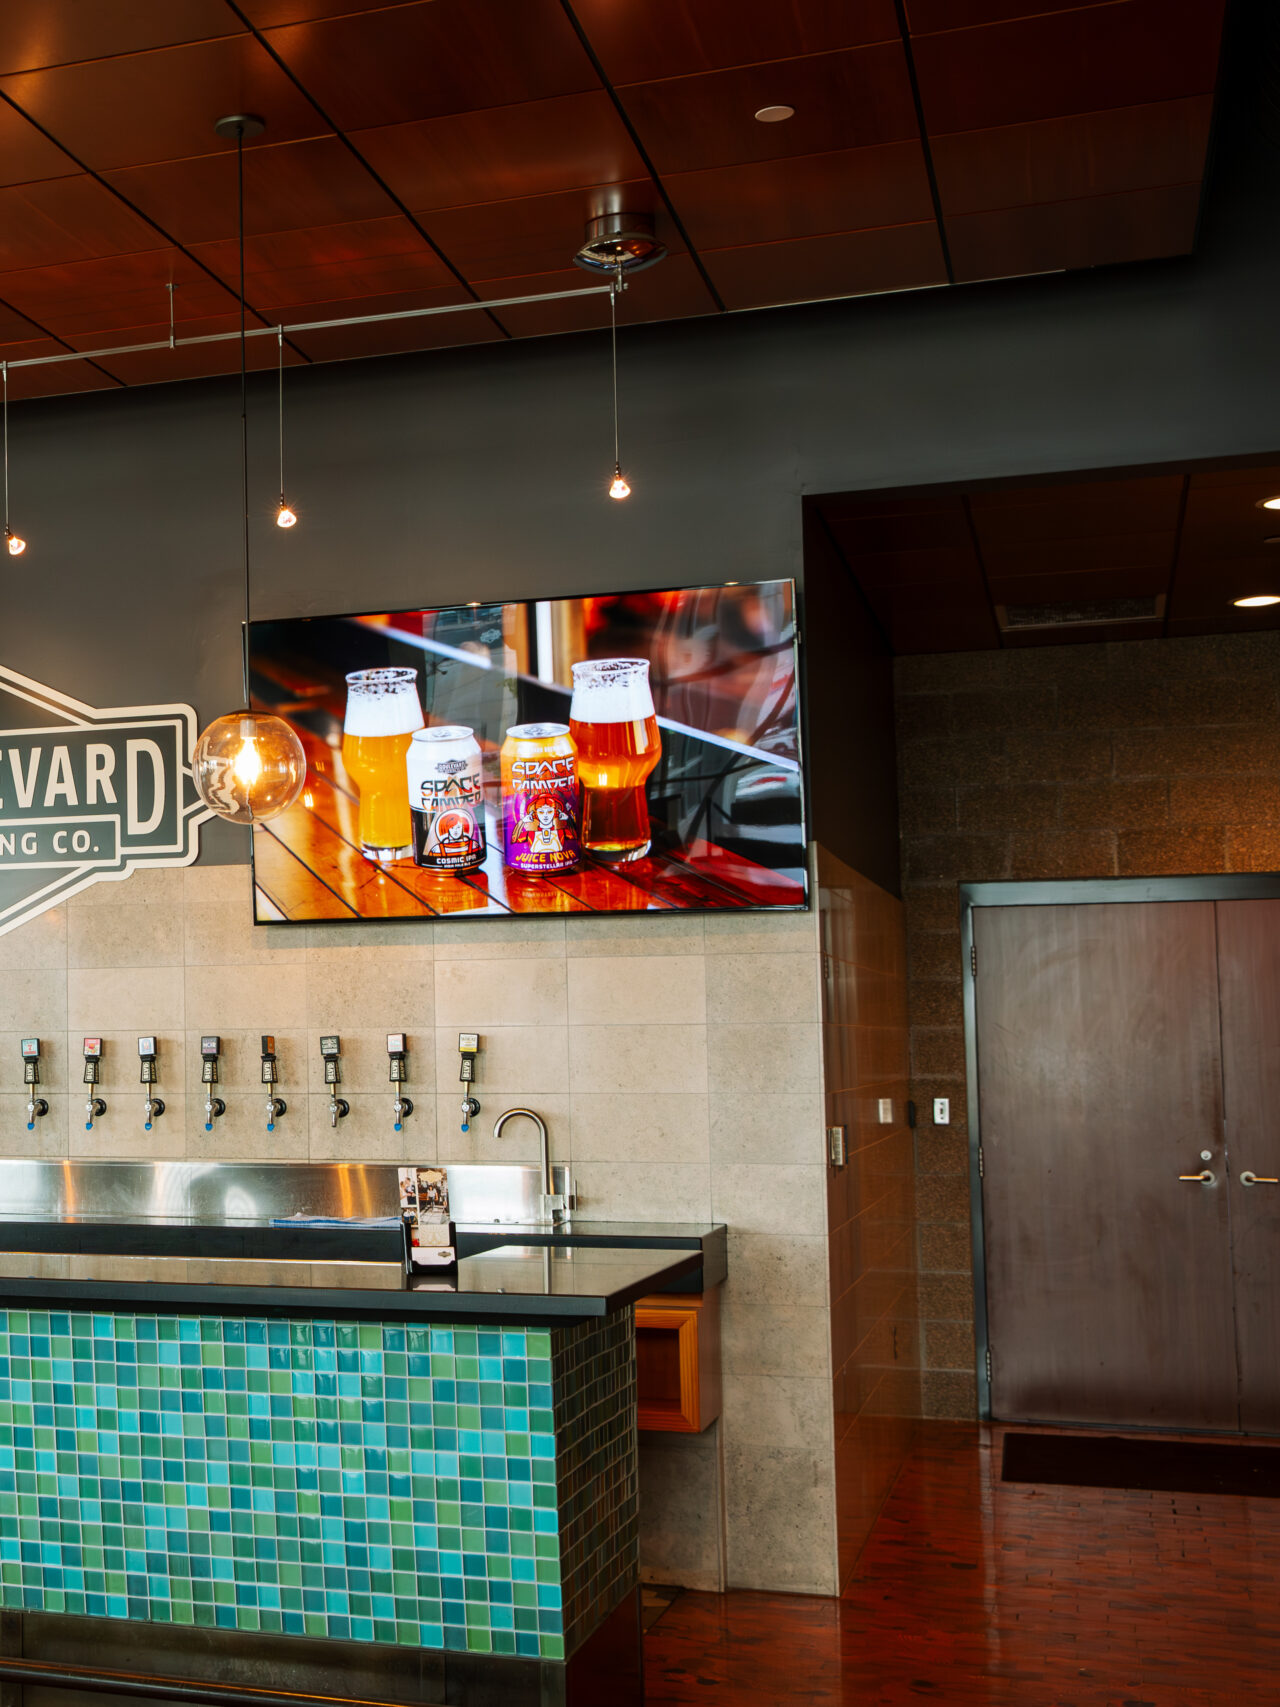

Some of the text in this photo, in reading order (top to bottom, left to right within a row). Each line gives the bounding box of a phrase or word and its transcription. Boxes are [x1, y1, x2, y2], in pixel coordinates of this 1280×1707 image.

[512, 757, 574, 780] SPACE
[421, 773, 480, 797] SPACE
[52, 829, 99, 855] CO.
[436, 856, 464, 864] COSMIC
[515, 850, 576, 863] JUICE NOVA
